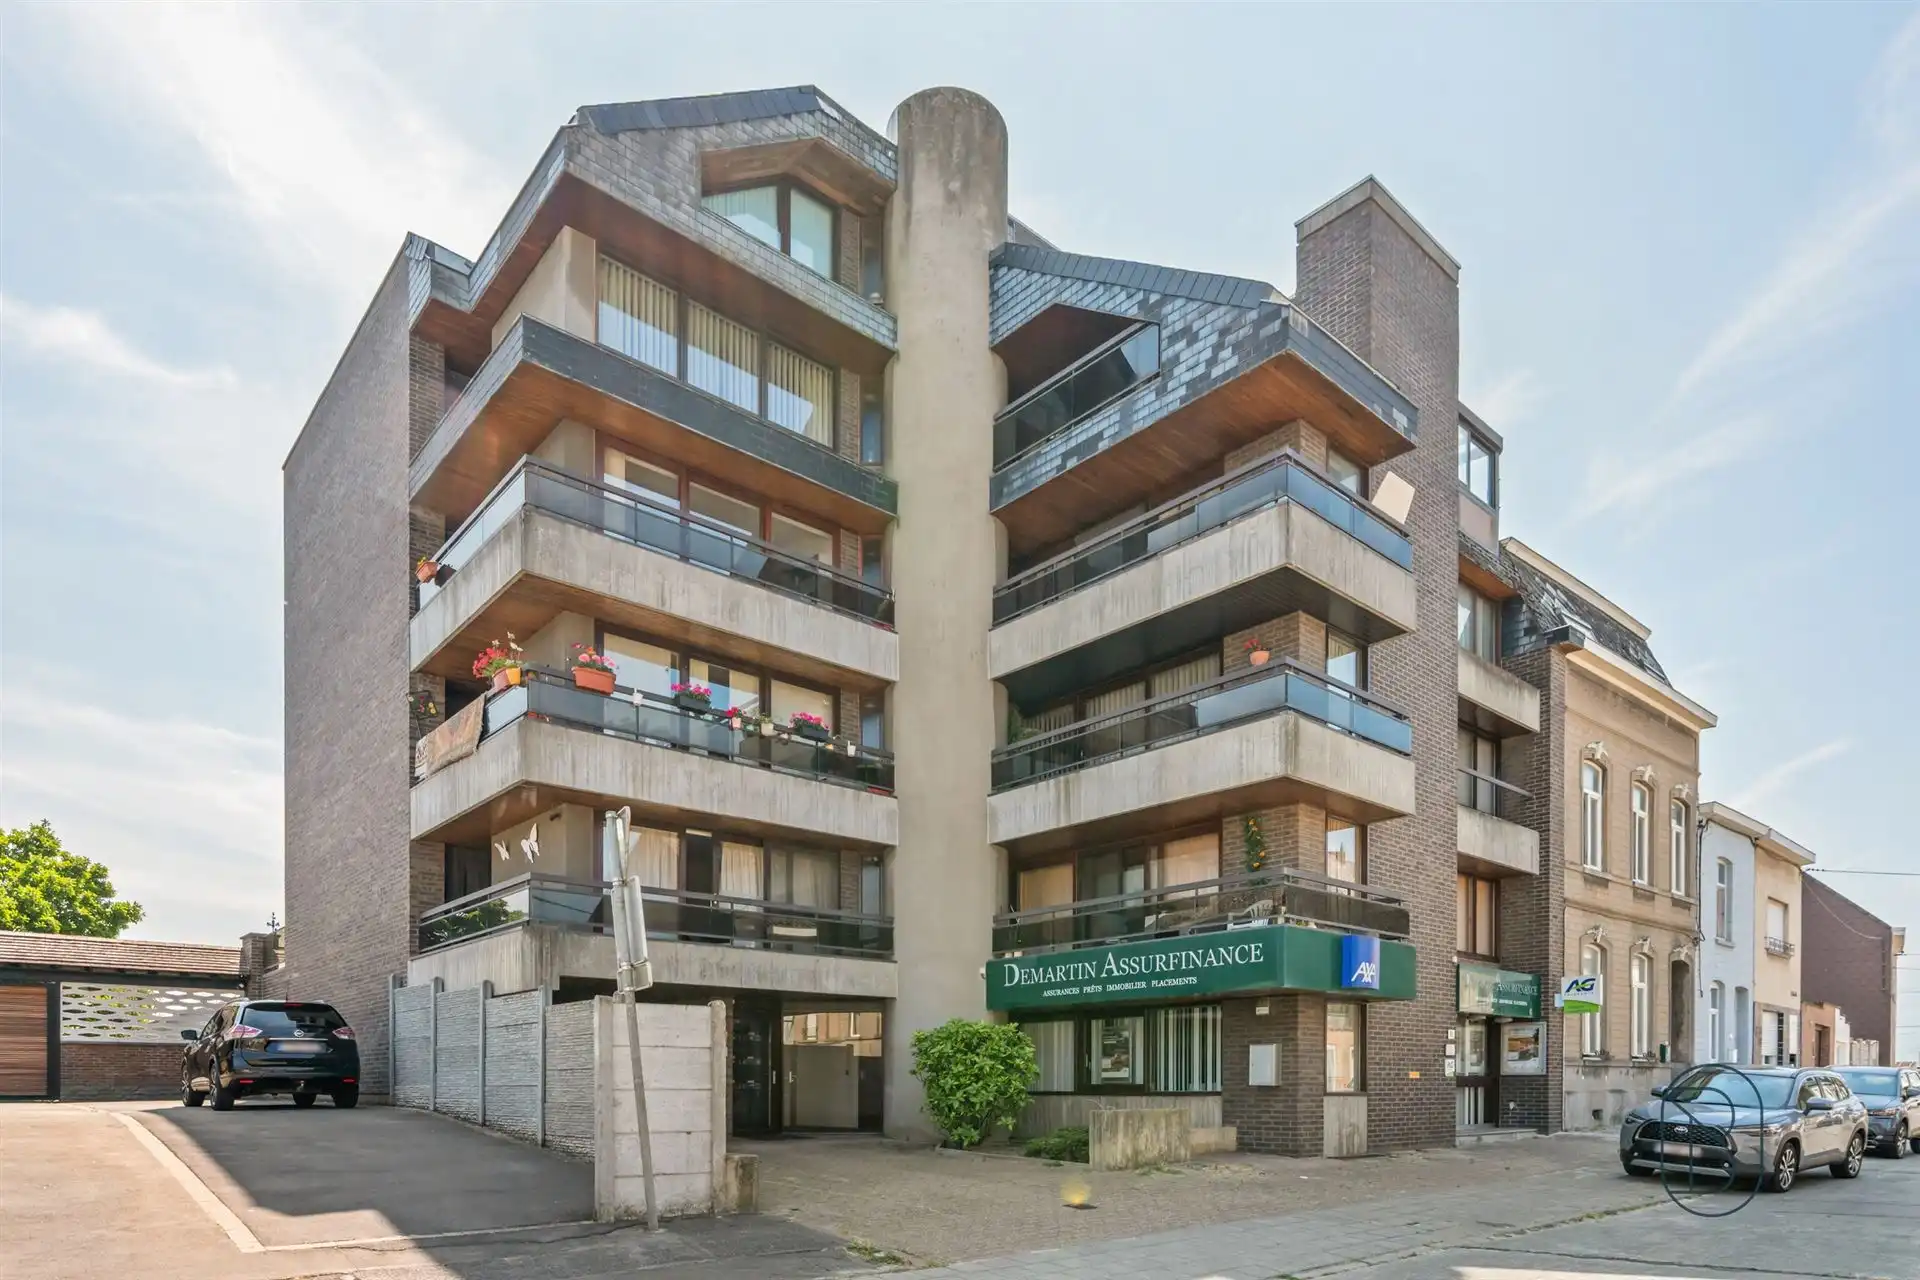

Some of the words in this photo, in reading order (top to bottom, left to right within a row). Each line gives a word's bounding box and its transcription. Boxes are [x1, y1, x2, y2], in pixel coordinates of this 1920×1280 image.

[1351, 961, 1377, 983] AXA
[1042, 987, 1080, 997] ASSURANCES
[1106, 981, 1147, 992] IMMOBILIER
[1151, 976, 1198, 988] PLACEMENTS
[1565, 978, 1596, 993] AG
